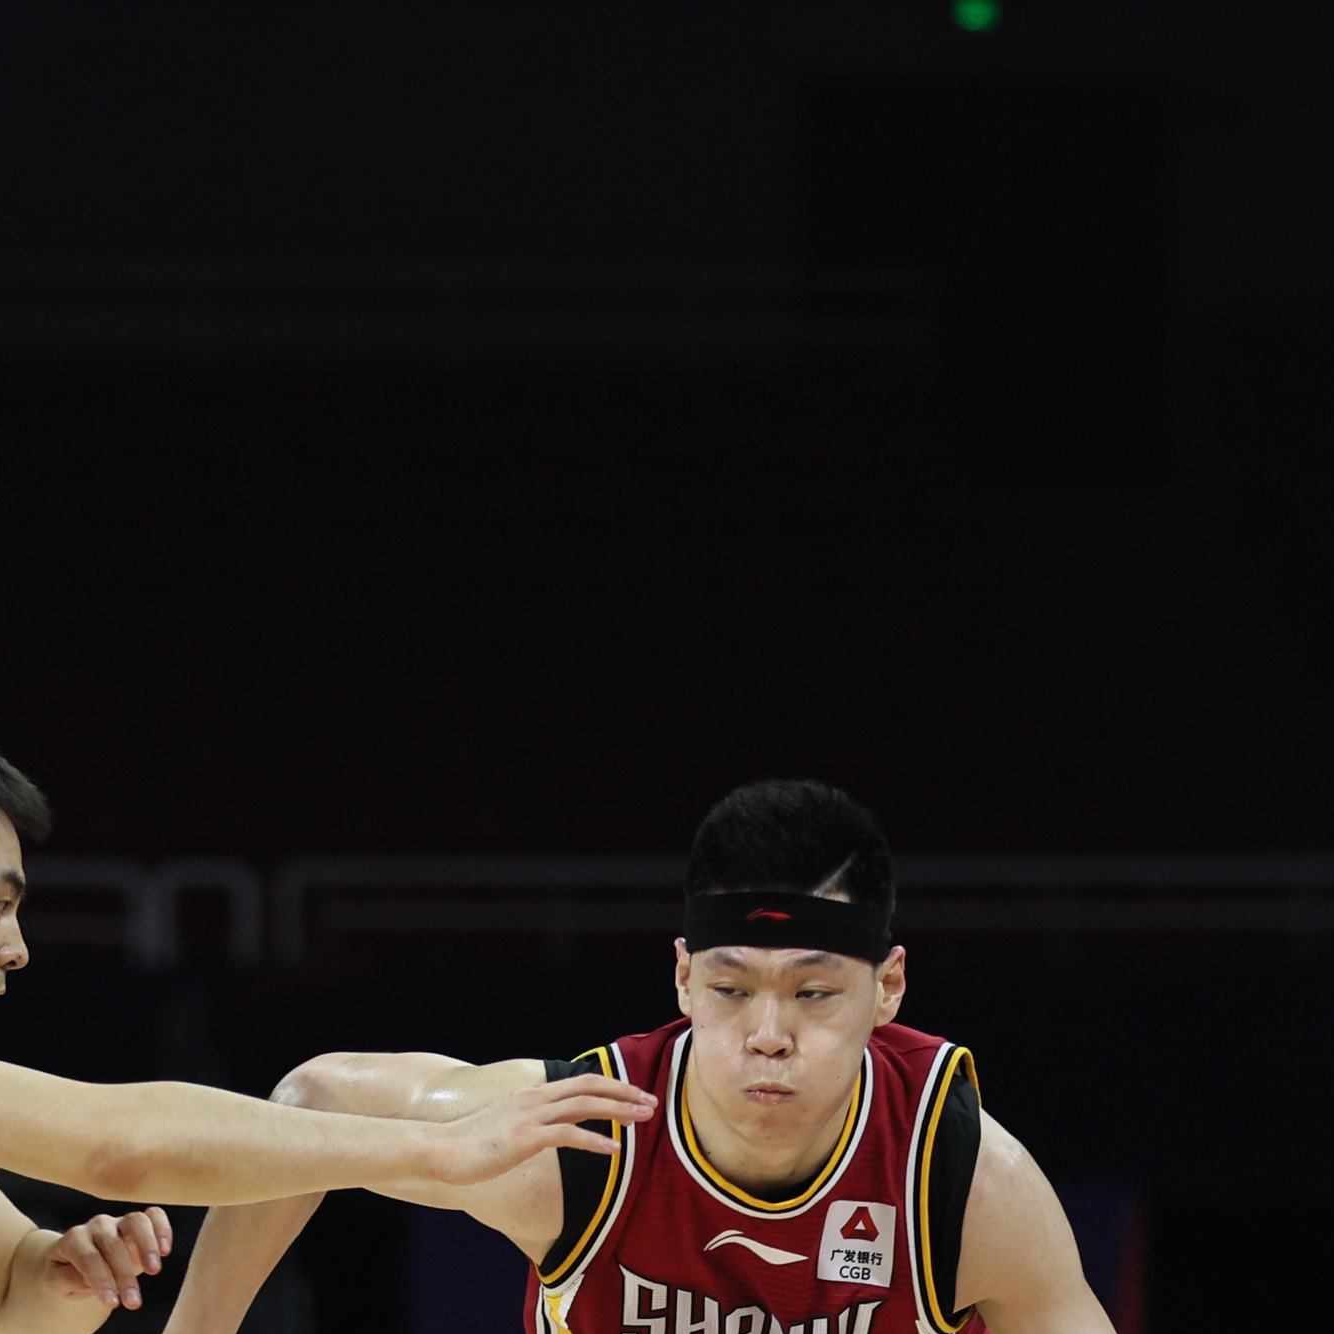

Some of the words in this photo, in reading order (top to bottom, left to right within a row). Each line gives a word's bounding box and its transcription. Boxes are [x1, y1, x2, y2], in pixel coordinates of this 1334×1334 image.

[830, 1249, 883, 1266] 广发银行
[839, 1265, 871, 1280] CGB
